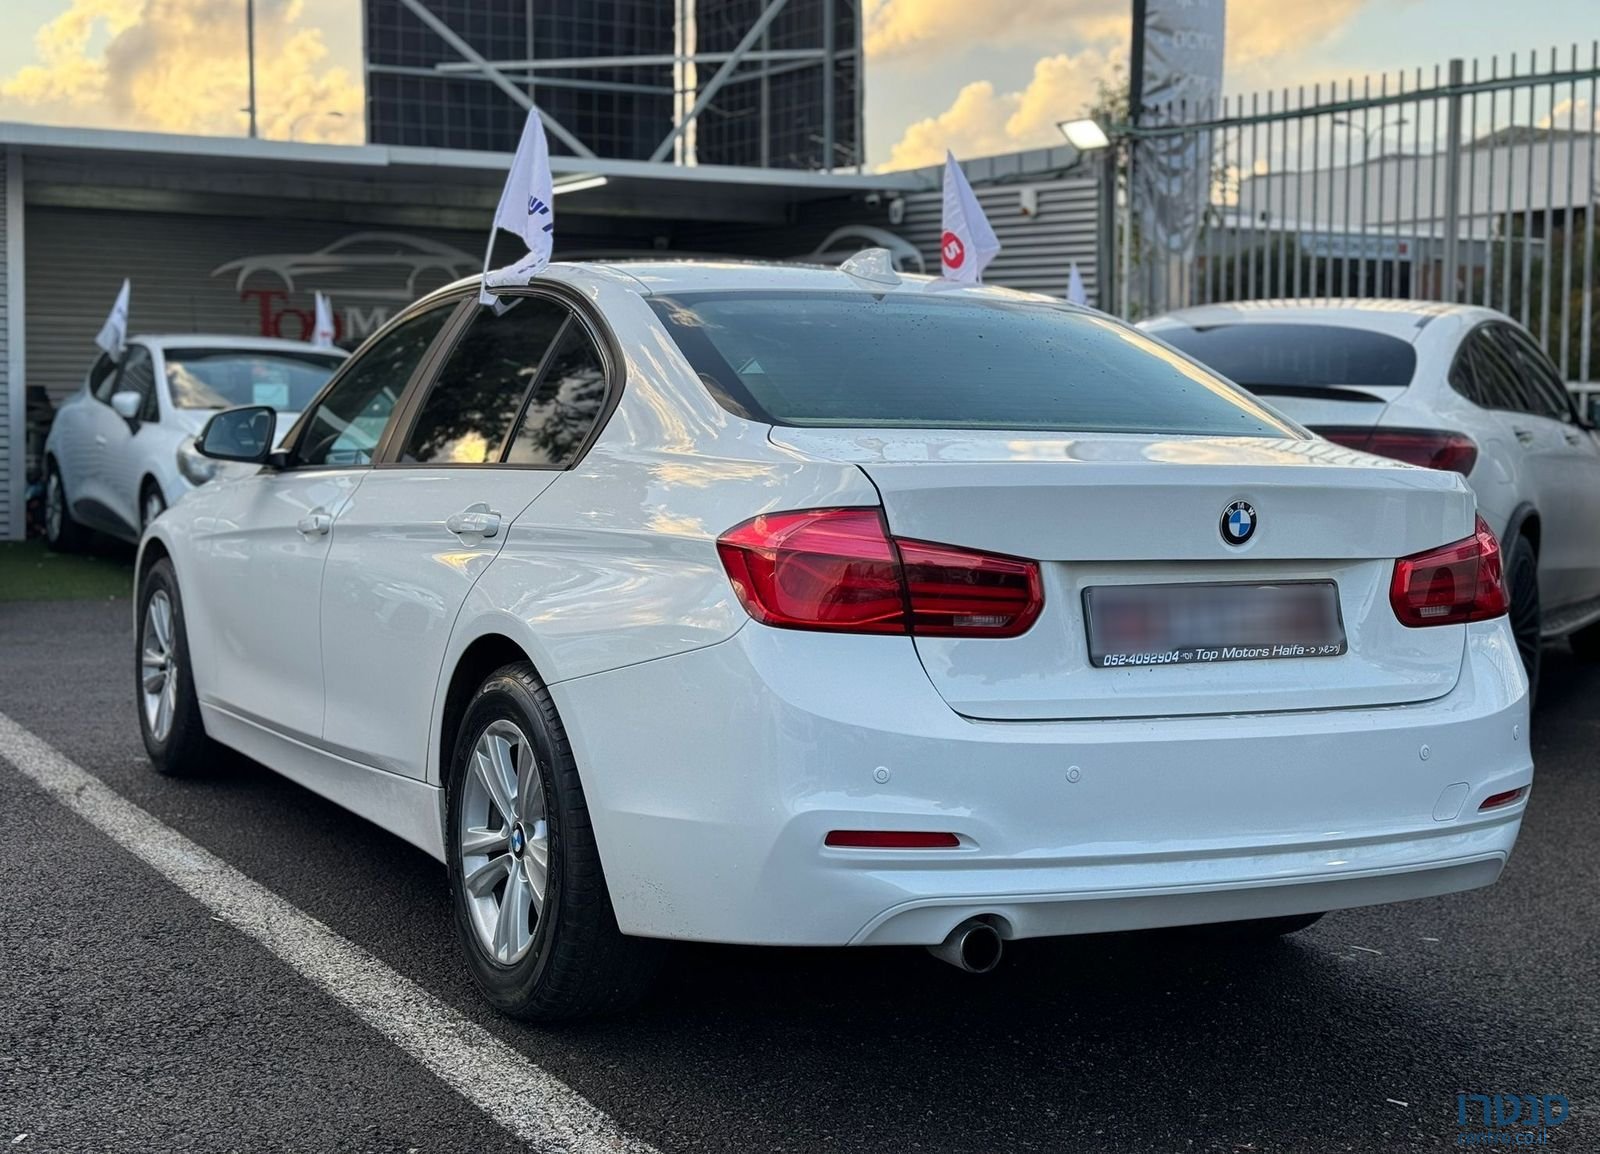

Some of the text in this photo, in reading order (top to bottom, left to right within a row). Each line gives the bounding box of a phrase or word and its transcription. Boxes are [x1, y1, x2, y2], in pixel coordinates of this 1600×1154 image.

[1196, 648, 1218, 661] Top
[1221, 647, 1270, 659] Motors
[1272, 644, 1305, 656] Haifa
[1103, 650, 1180, 666] 052-4092904
